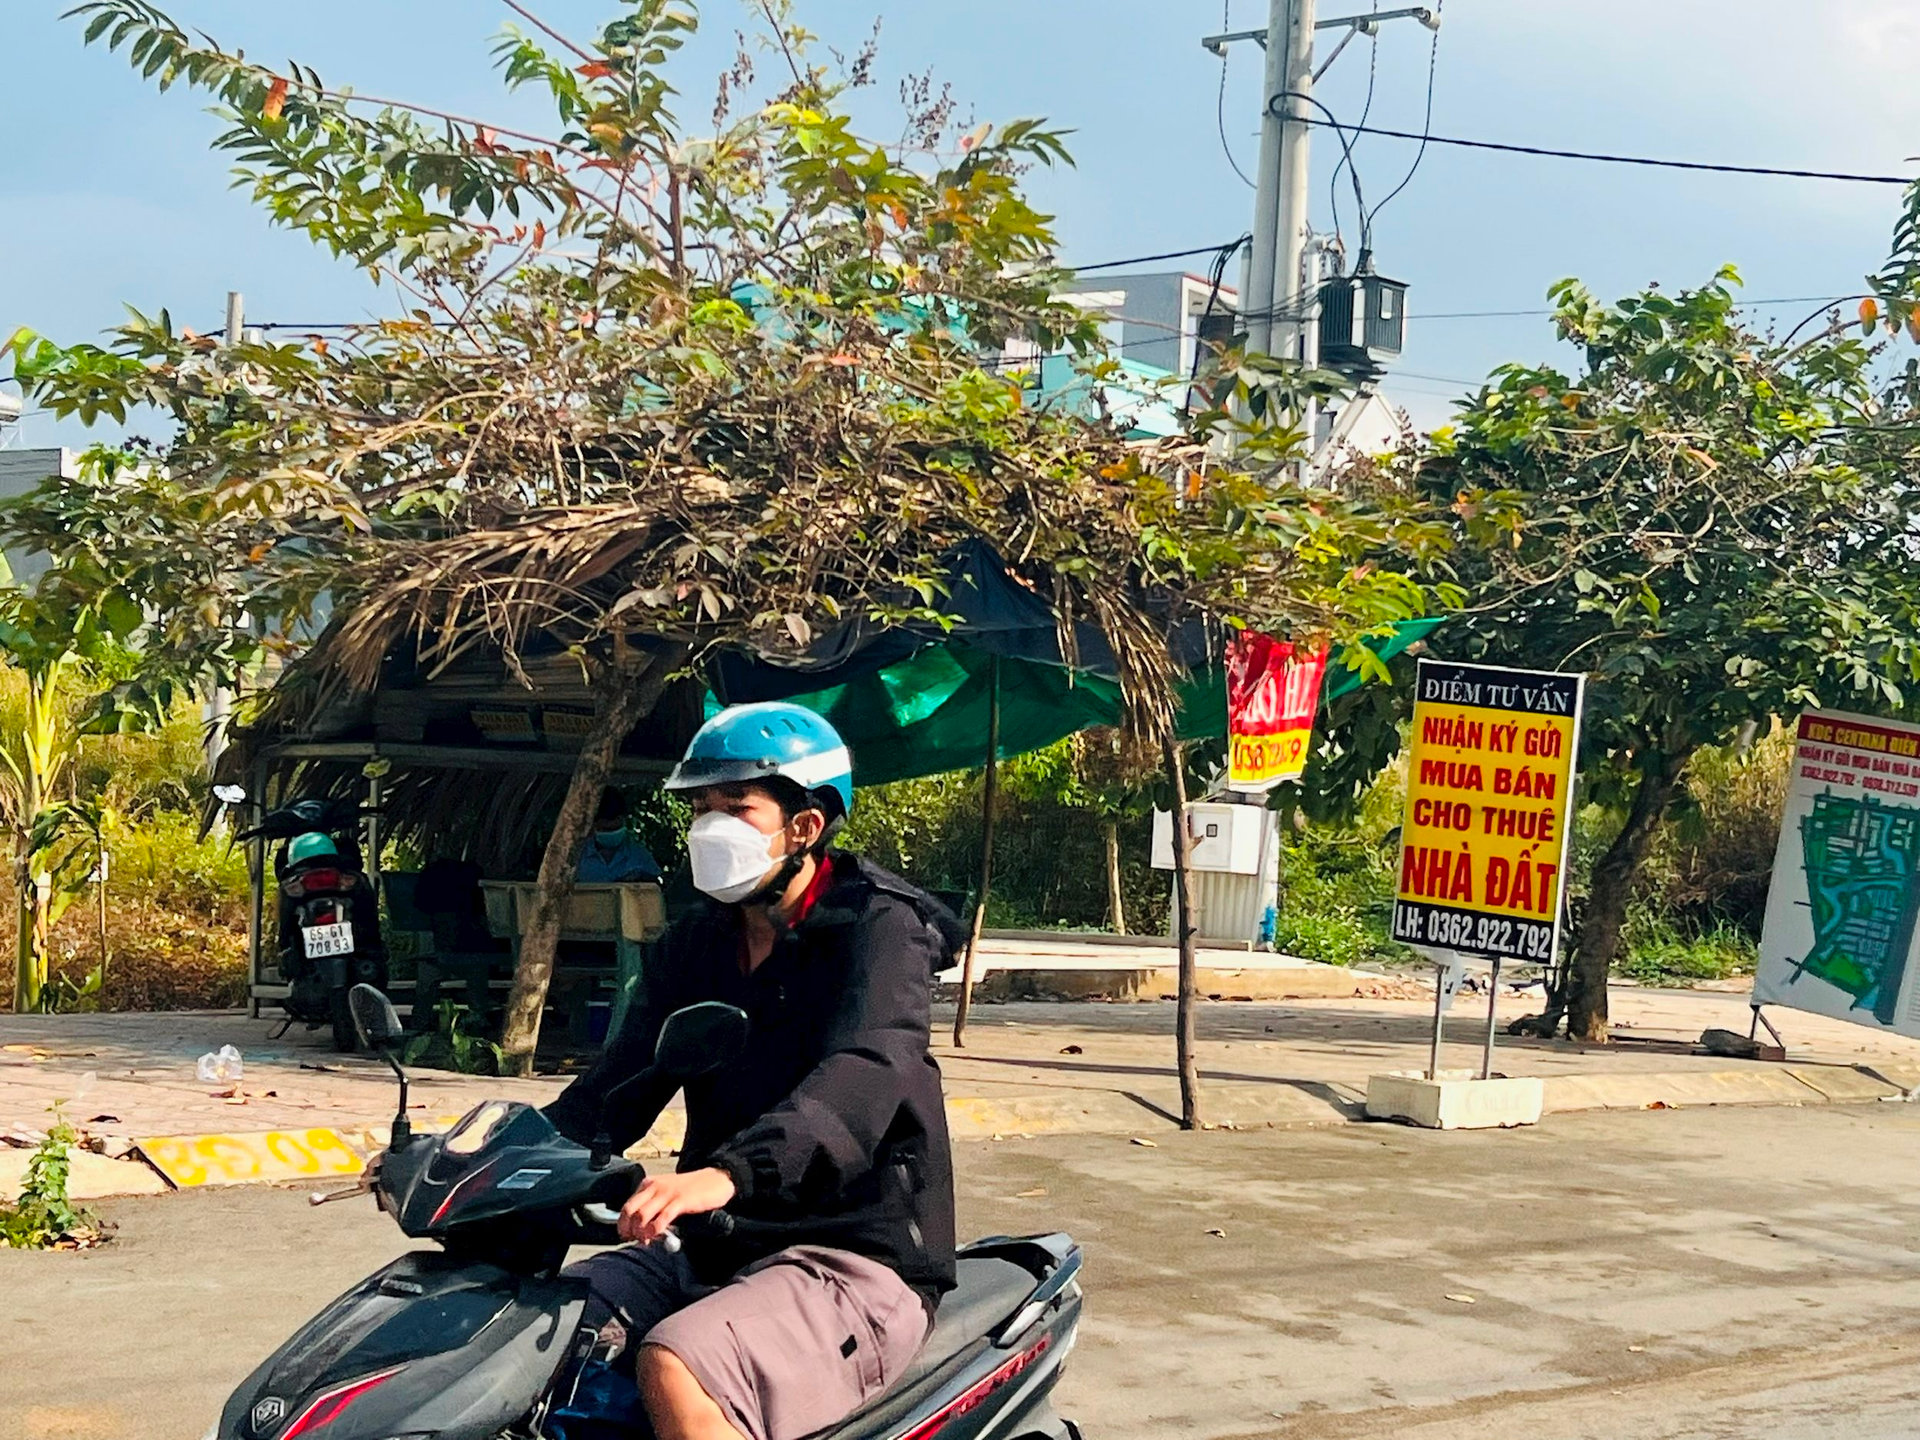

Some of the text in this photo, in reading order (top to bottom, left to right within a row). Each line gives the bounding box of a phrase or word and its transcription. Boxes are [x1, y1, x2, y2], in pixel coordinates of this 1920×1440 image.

[1425, 670, 1569, 712] ĐIỂM TƯ VẤN
[1422, 714, 1561, 759] NHẬN KÝ GỬI
[1420, 760, 1556, 800] MUA BÁN
[1414, 799, 1556, 842] CHO THUÊ
[1401, 842, 1557, 914] NHÀ ĐẤT
[1395, 903, 1550, 959] LH: 0362.922.792
